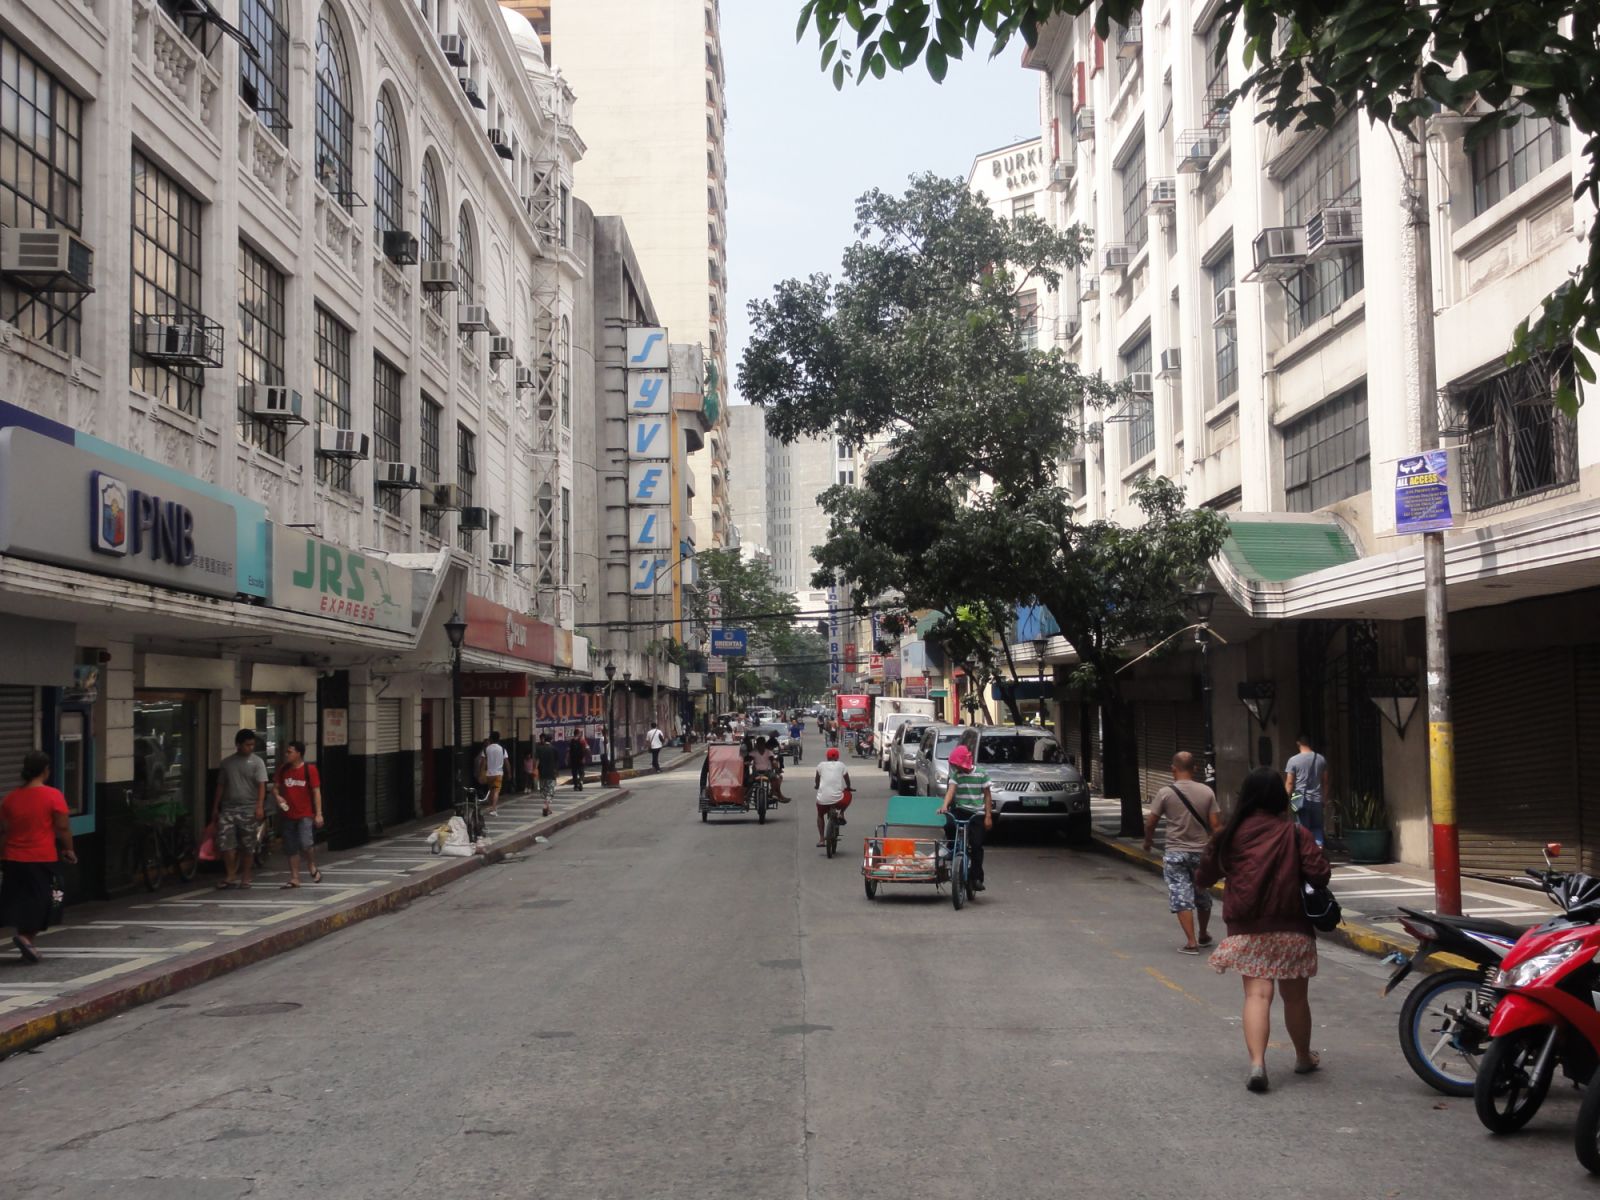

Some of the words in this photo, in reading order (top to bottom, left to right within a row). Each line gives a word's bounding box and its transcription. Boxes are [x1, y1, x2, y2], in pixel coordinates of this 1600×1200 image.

[1006, 170, 1038, 189] BLDG
[1396, 478, 1408, 487] ALL
[1409, 474, 1438, 485] ACCESS
[129, 489, 195, 567] PNB
[293, 539, 366, 602] JRS
[320, 596, 376, 621] EXPRESS
[830, 642, 840, 684] BANK
[535, 686, 581, 695] ELCOME
[535, 693, 604, 721] SCOLTA
